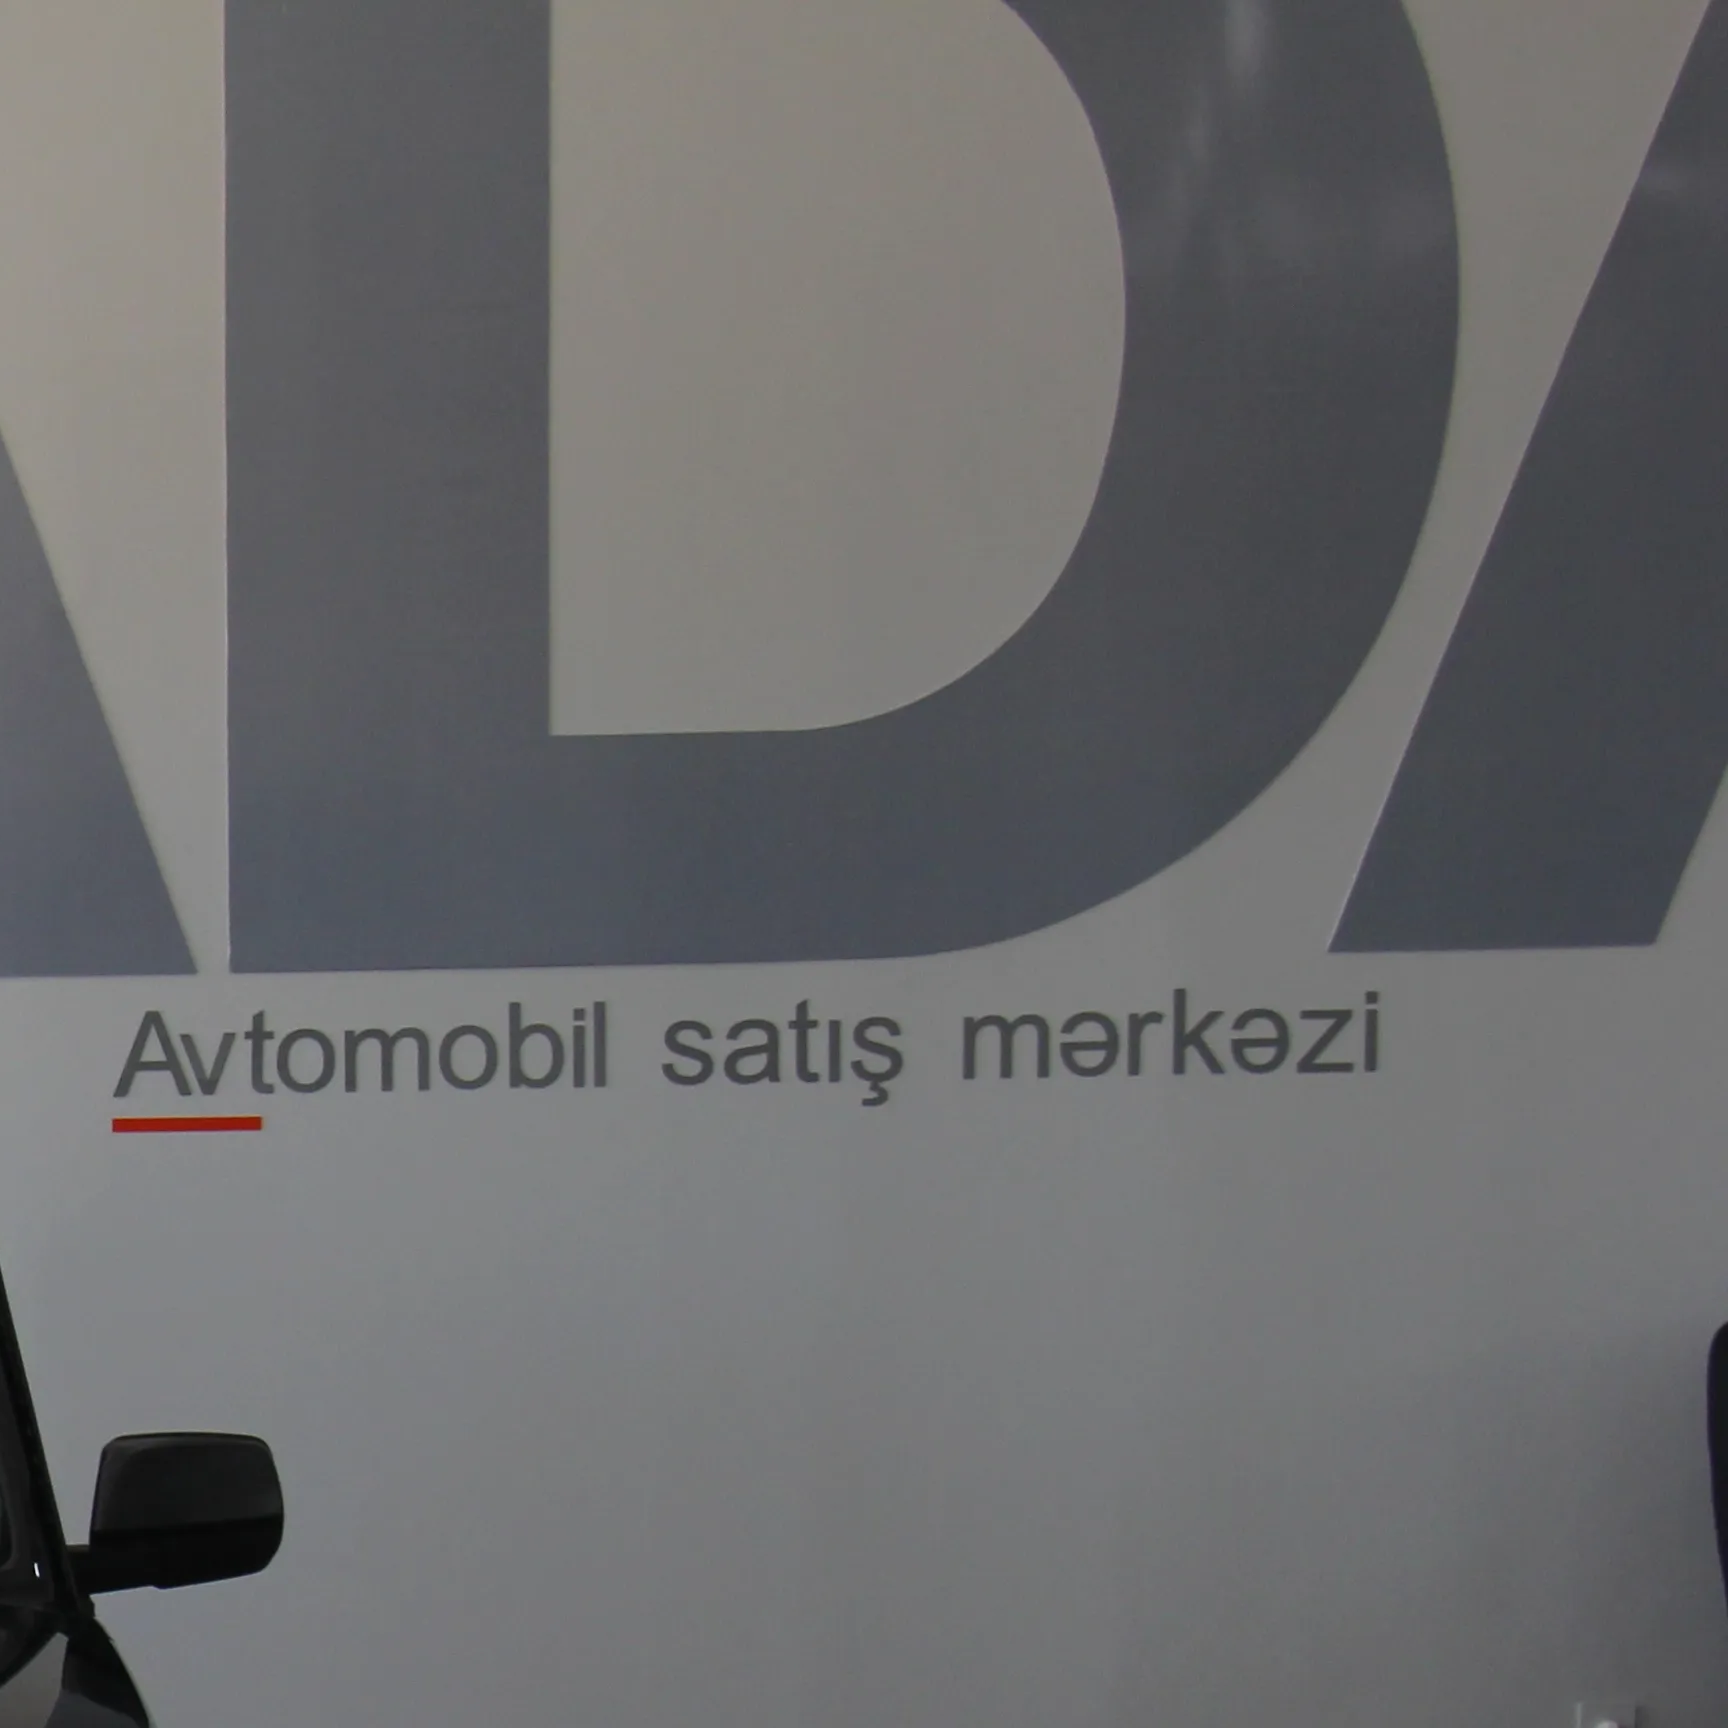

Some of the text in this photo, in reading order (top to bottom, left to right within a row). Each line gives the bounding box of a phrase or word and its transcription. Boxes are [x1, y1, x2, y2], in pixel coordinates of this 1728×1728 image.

[113, 988, 1381, 1107] Avtomobil satış mərkəzi
